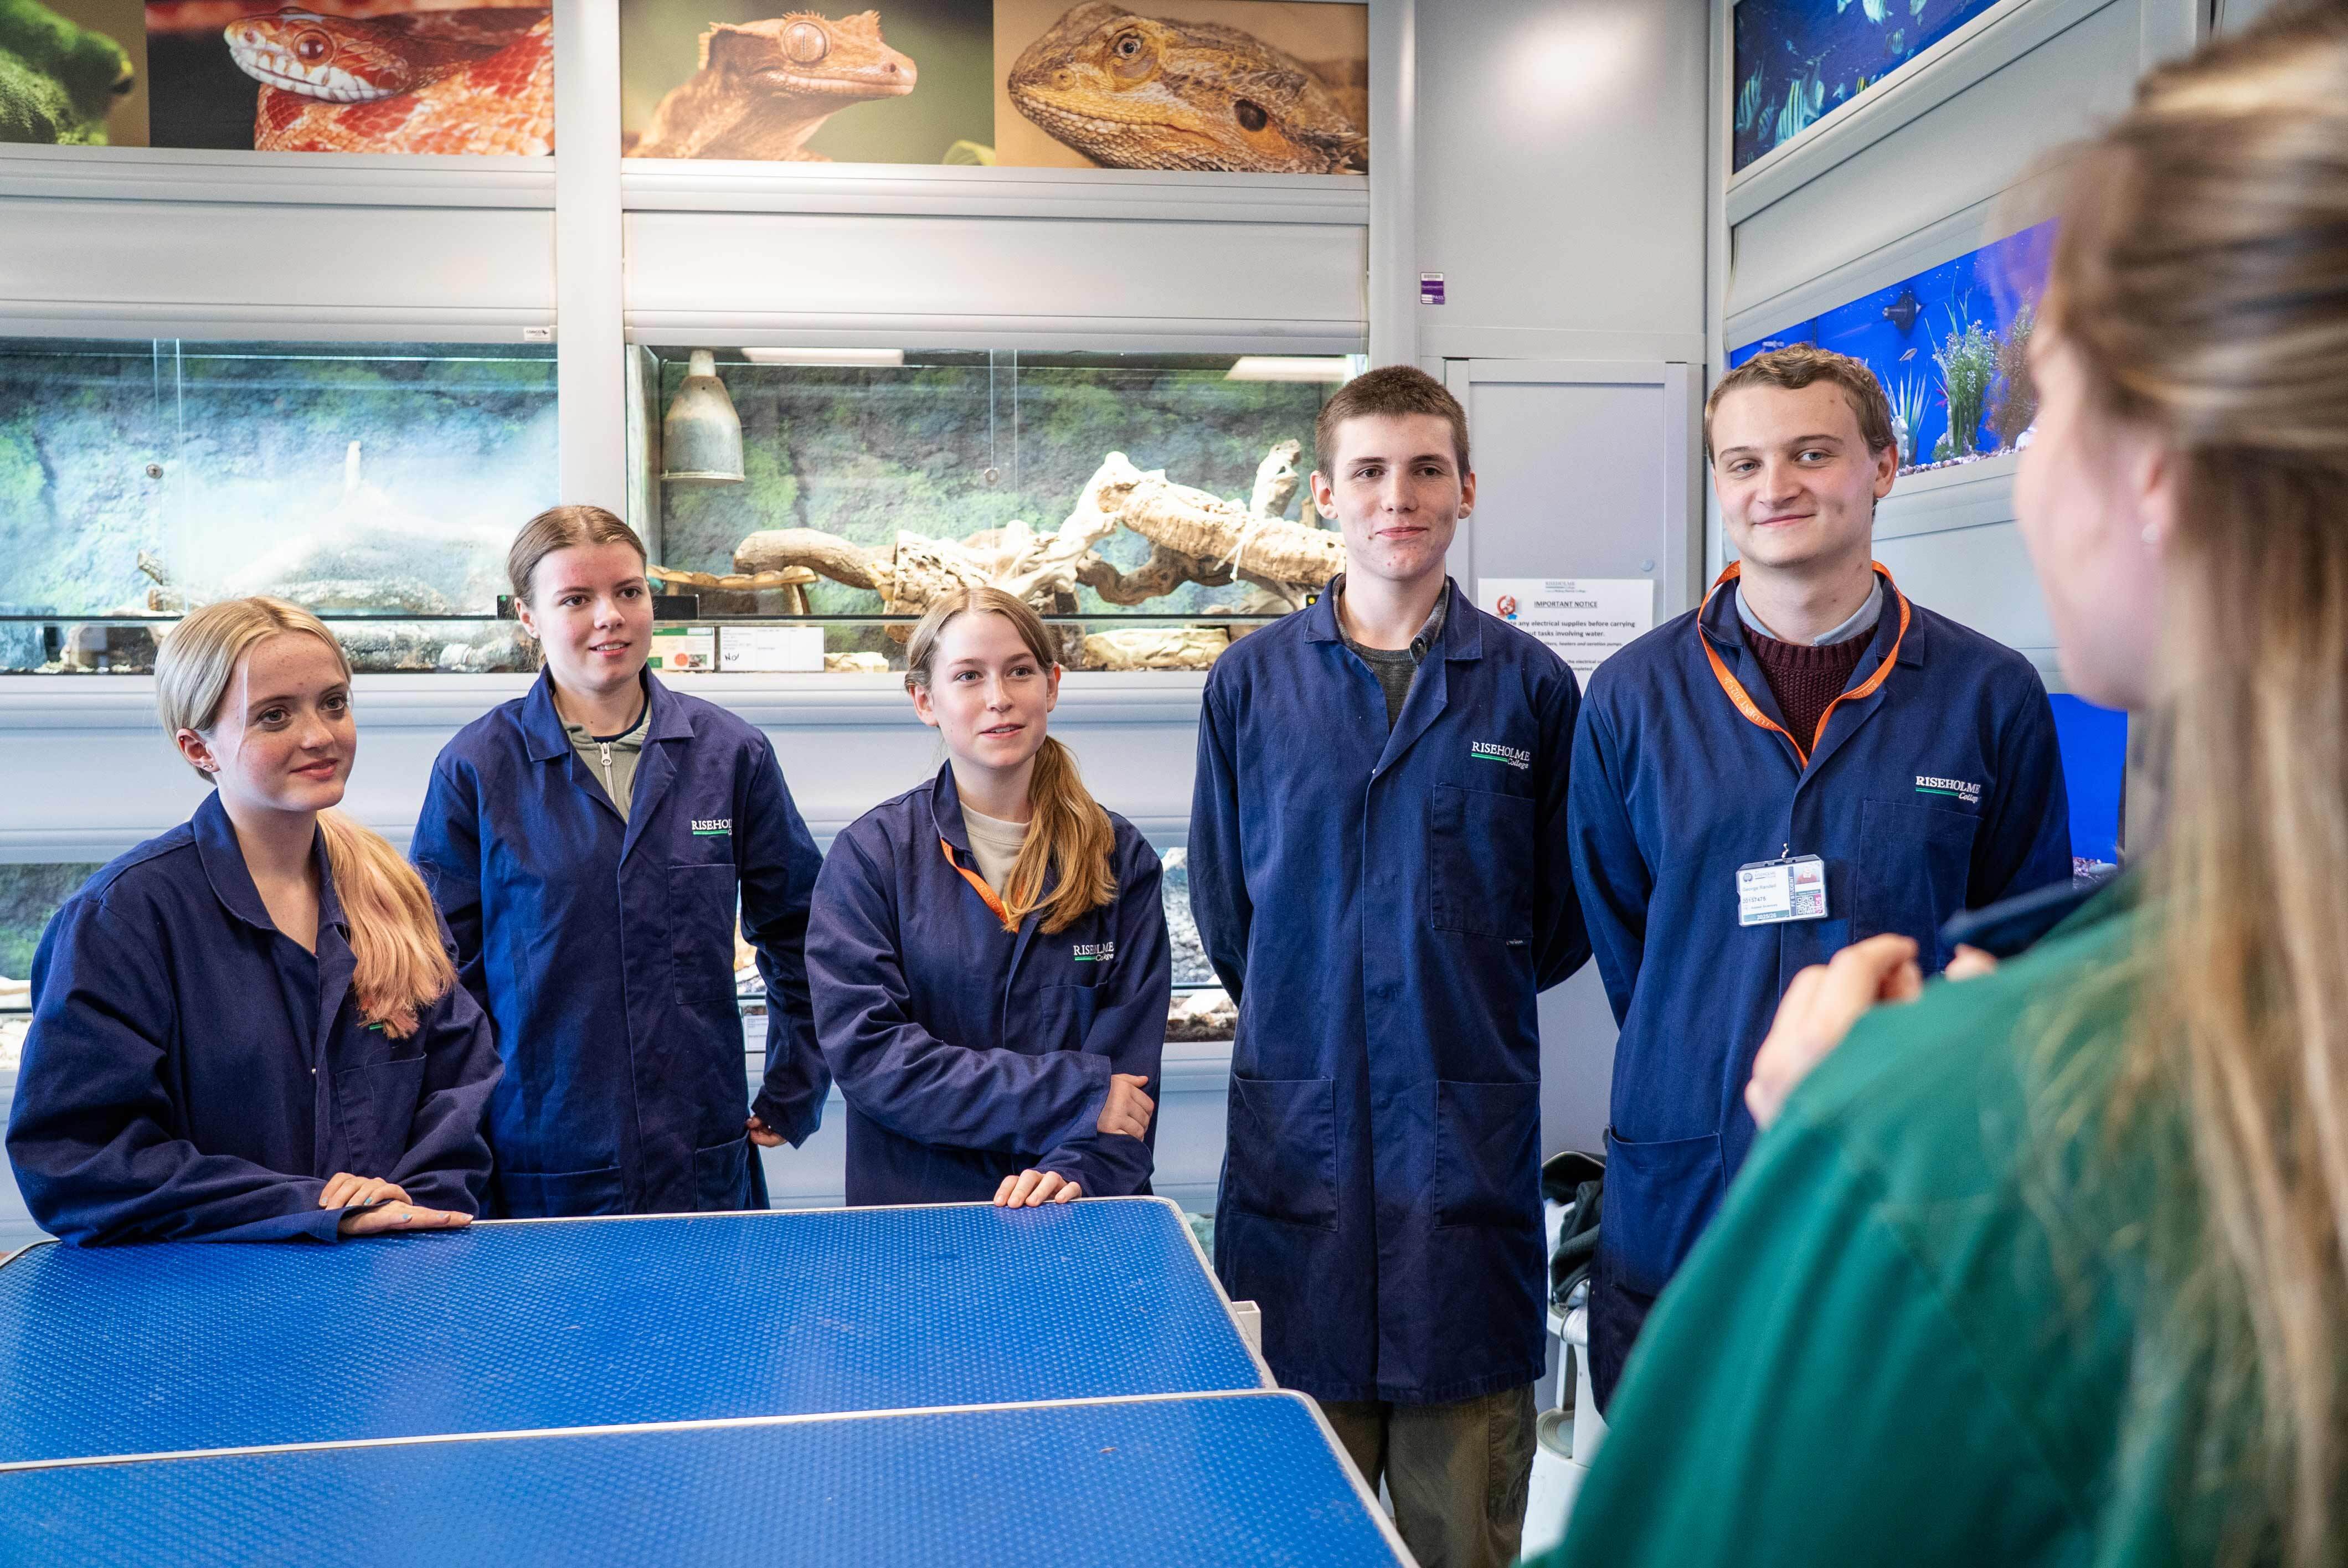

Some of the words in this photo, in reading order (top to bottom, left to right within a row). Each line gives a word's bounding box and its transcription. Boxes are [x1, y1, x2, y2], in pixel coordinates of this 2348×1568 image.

[1471, 741, 1530, 761] RISEHOLME
[1507, 758, 1529, 770] College
[1916, 776, 1981, 793] RISEHOLME
[691, 818, 732, 830] RISEHOL
[1073, 941, 1114, 956] RISELME
